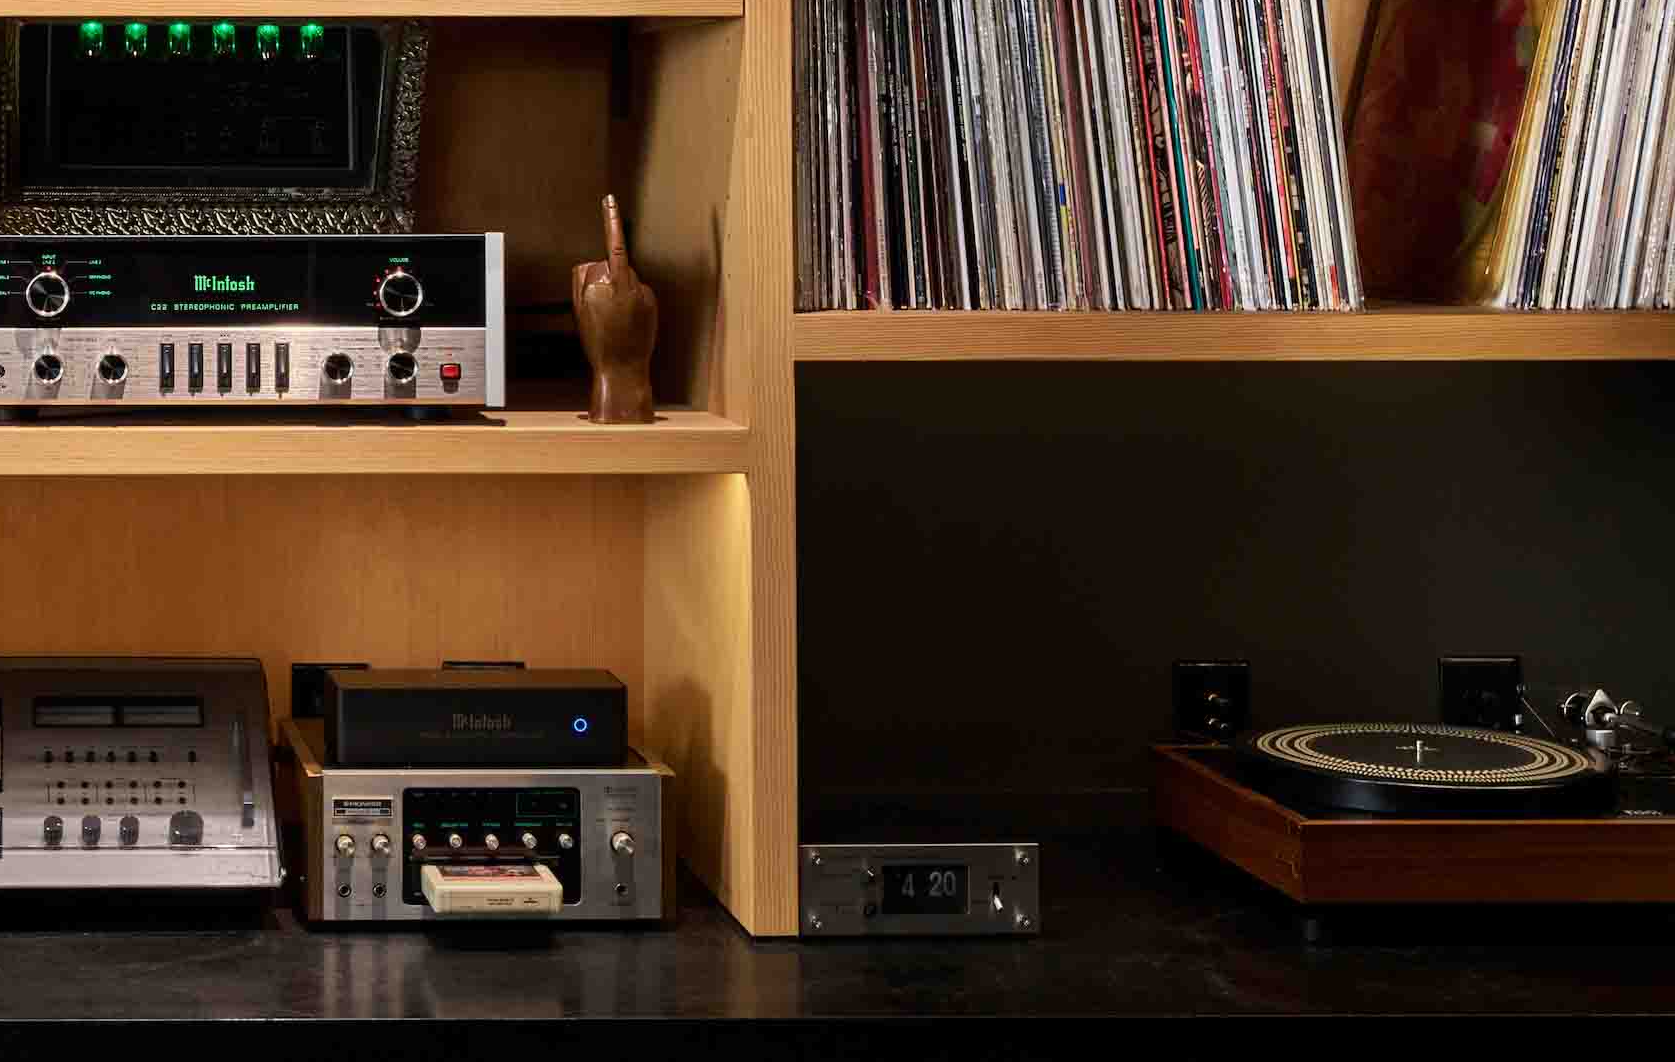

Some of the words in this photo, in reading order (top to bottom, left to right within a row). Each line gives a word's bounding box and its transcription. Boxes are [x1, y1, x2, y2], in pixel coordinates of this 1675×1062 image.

[194, 274, 255, 291] McIntosh
[150, 303, 168, 311] C22
[174, 303, 235, 311] STEREOPHONIC
[241, 303, 299, 311] PREAMPLIFIER
[901, 873, 915, 898] 4
[929, 871, 957, 897] 20
